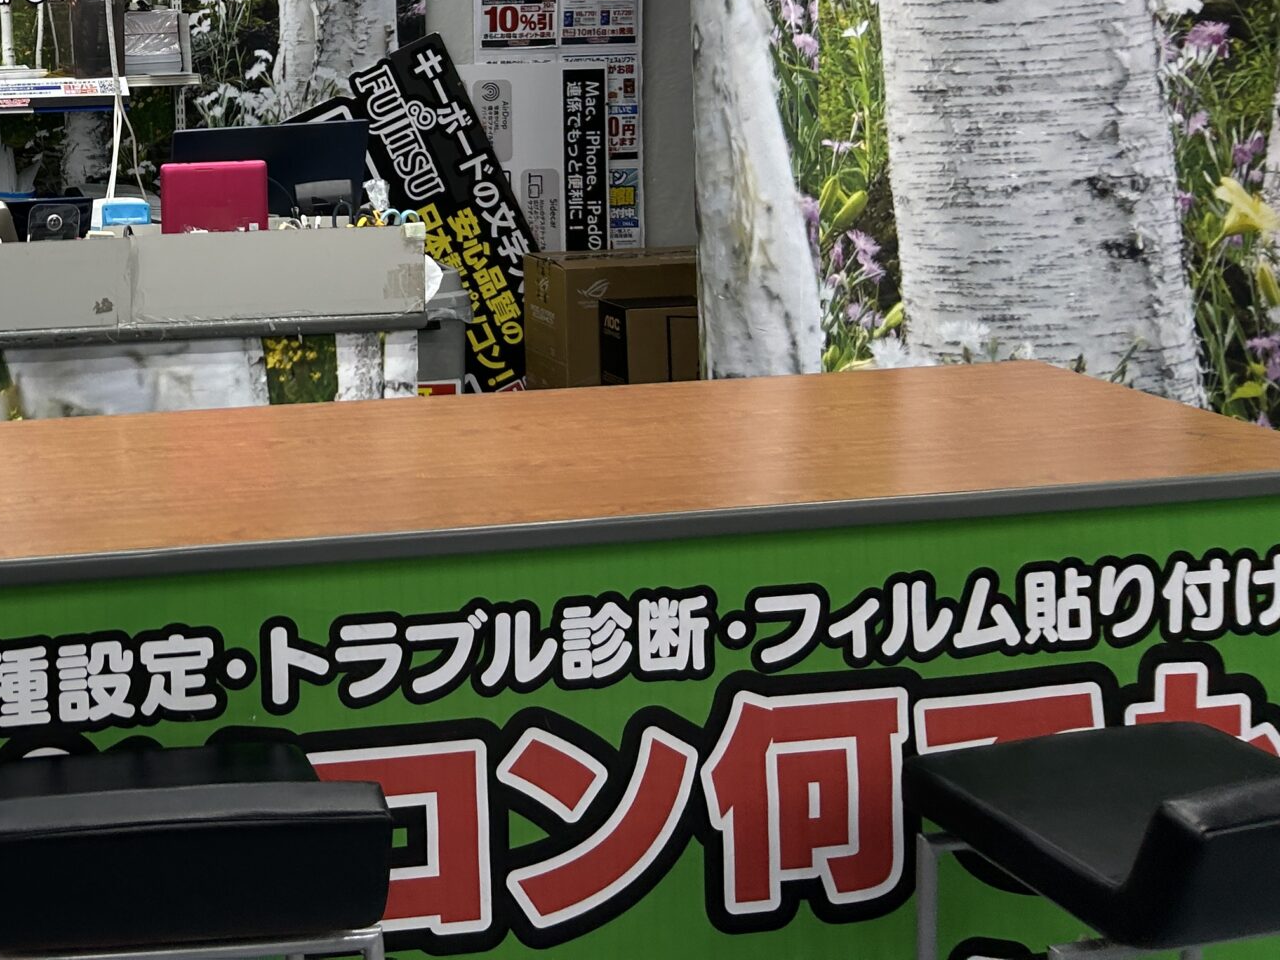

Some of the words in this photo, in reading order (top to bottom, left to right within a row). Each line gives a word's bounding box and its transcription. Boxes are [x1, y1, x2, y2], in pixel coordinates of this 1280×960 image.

[355, 64, 445, 200] FUJITSU
[414, 48, 526, 302] キーボードの文字
[447, 206, 524, 344] 安心品質の
